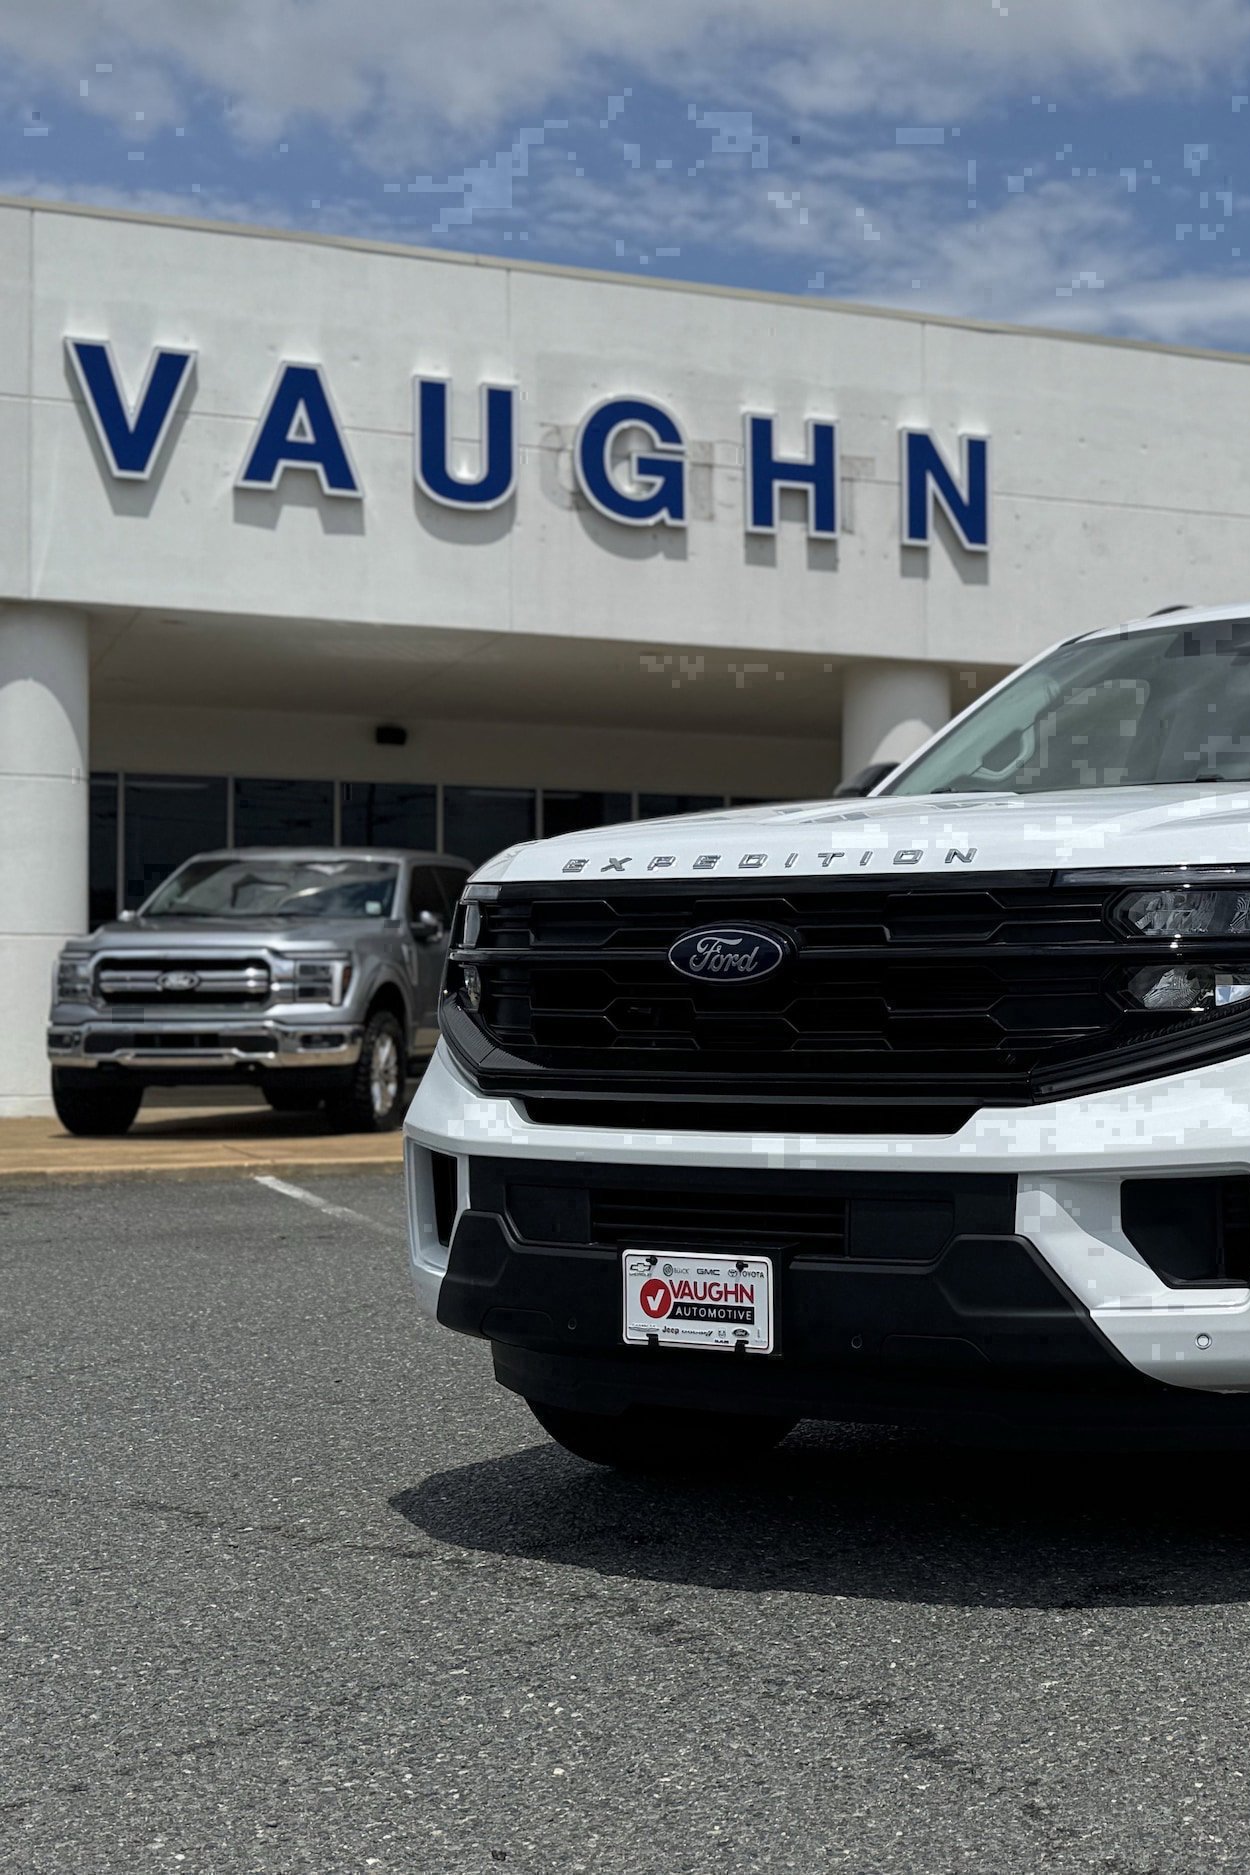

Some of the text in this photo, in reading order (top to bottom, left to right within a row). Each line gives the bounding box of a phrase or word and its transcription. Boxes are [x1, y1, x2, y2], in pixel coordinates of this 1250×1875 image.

[64, 336, 991, 552] VAUGHN
[561, 847, 978, 874] EXPEDITION
[688, 936, 760, 972] Ford
[669, 1280, 754, 1304] VAUGHN
[675, 1307, 753, 1321] AUTOMOTIVE
[662, 1325, 680, 1335] Jeep
